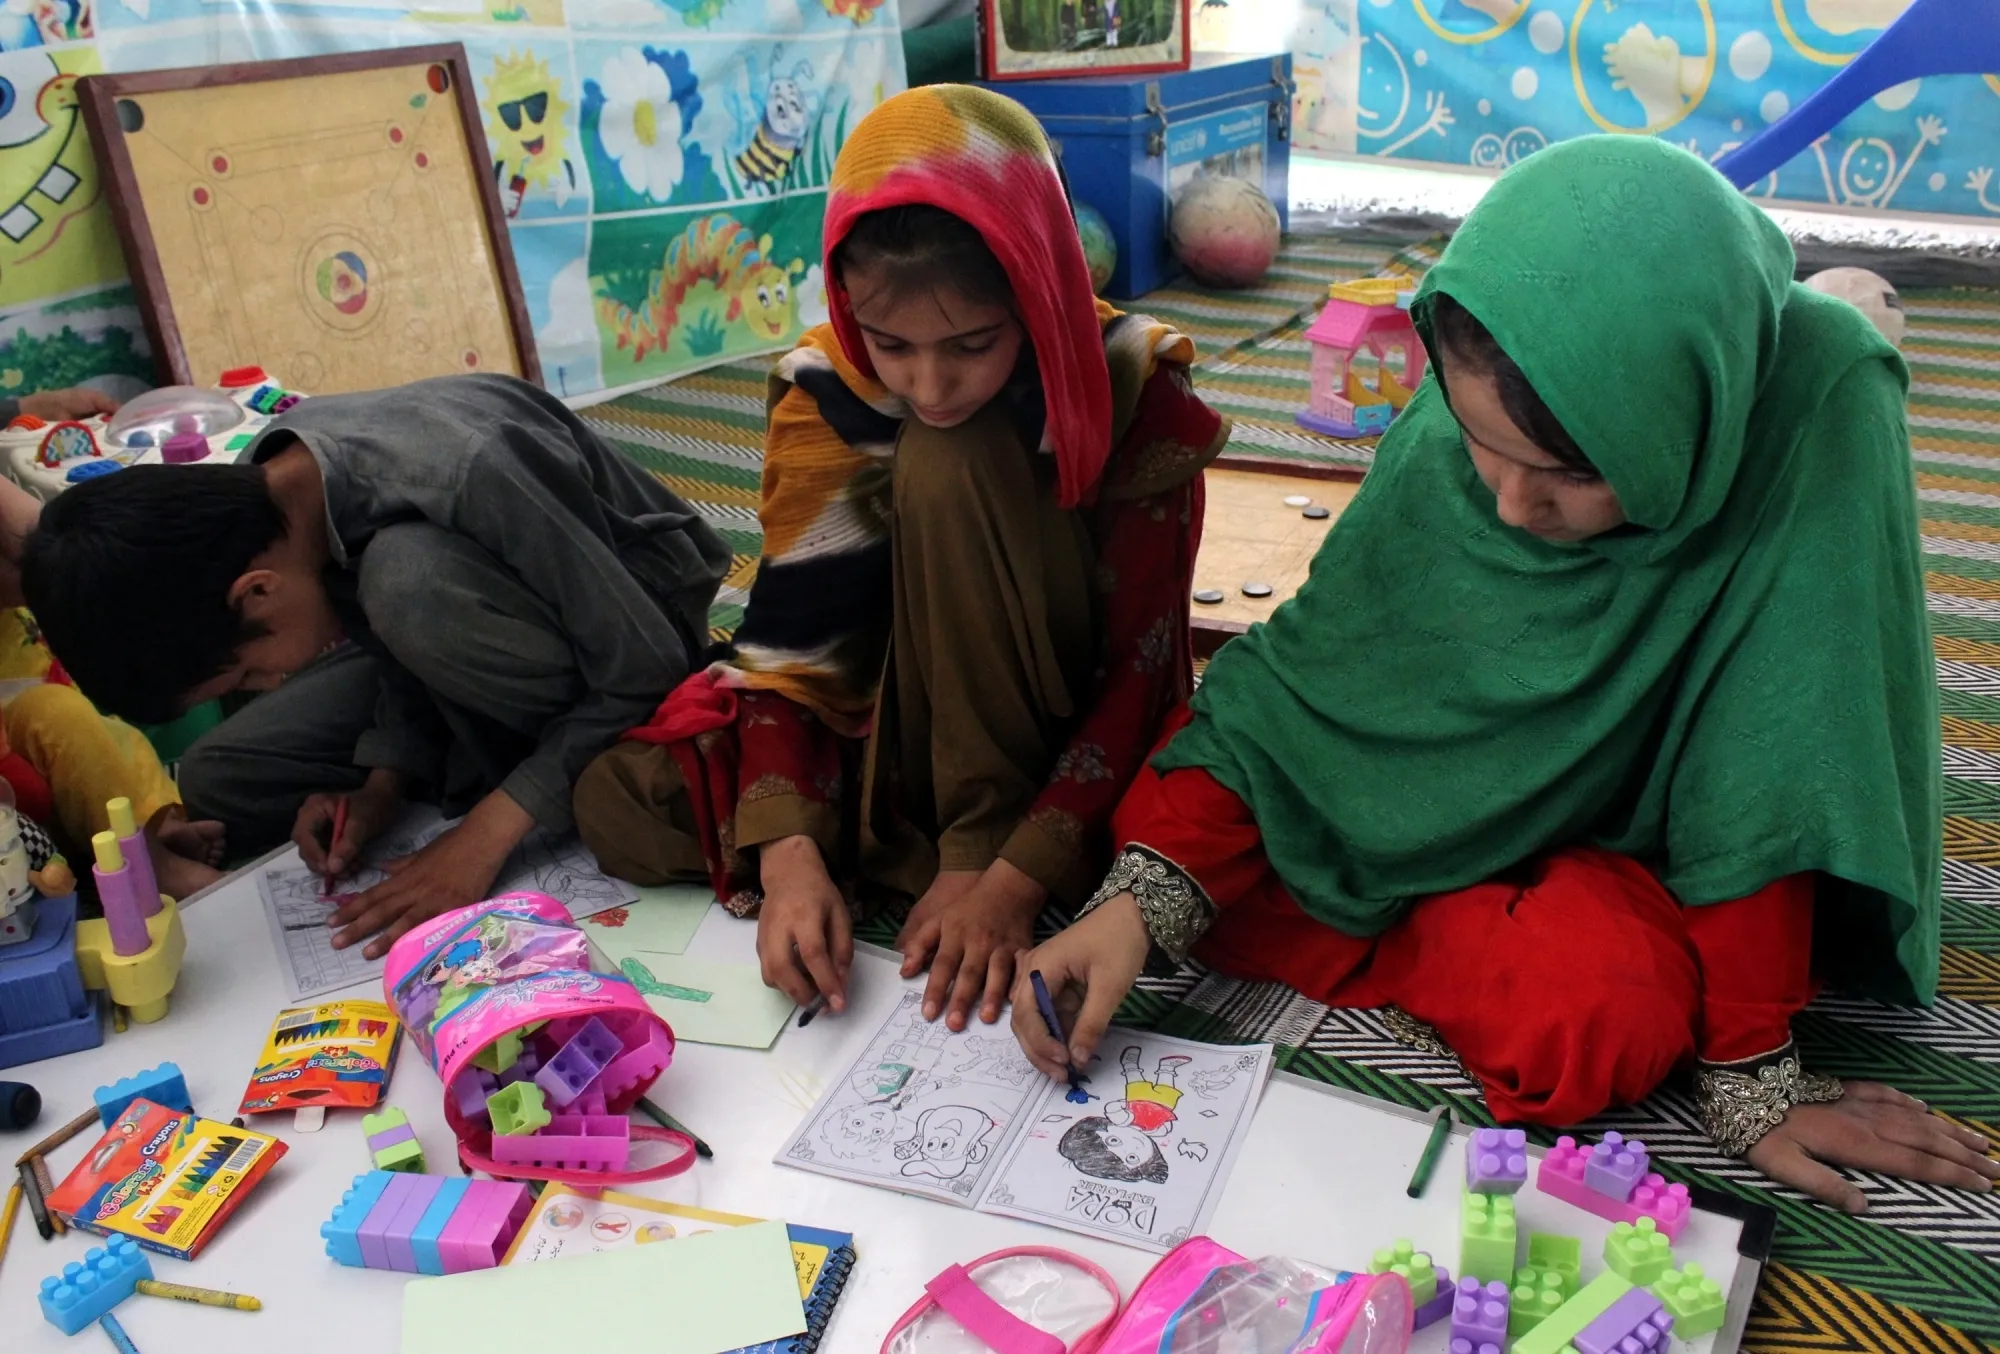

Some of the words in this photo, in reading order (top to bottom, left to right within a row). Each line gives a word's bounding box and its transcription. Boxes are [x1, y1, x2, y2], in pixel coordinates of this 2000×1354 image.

[259, 1069, 301, 1083] Crayons
[305, 1056, 380, 1070] Colorart
[142, 1119, 179, 1156] Crayons
[95, 1158, 157, 1221] Colorart
[136, 1172, 166, 1200] kids
[1078, 1180, 1155, 1205] EXPLORER
[1065, 1186, 1157, 1235] DORA
